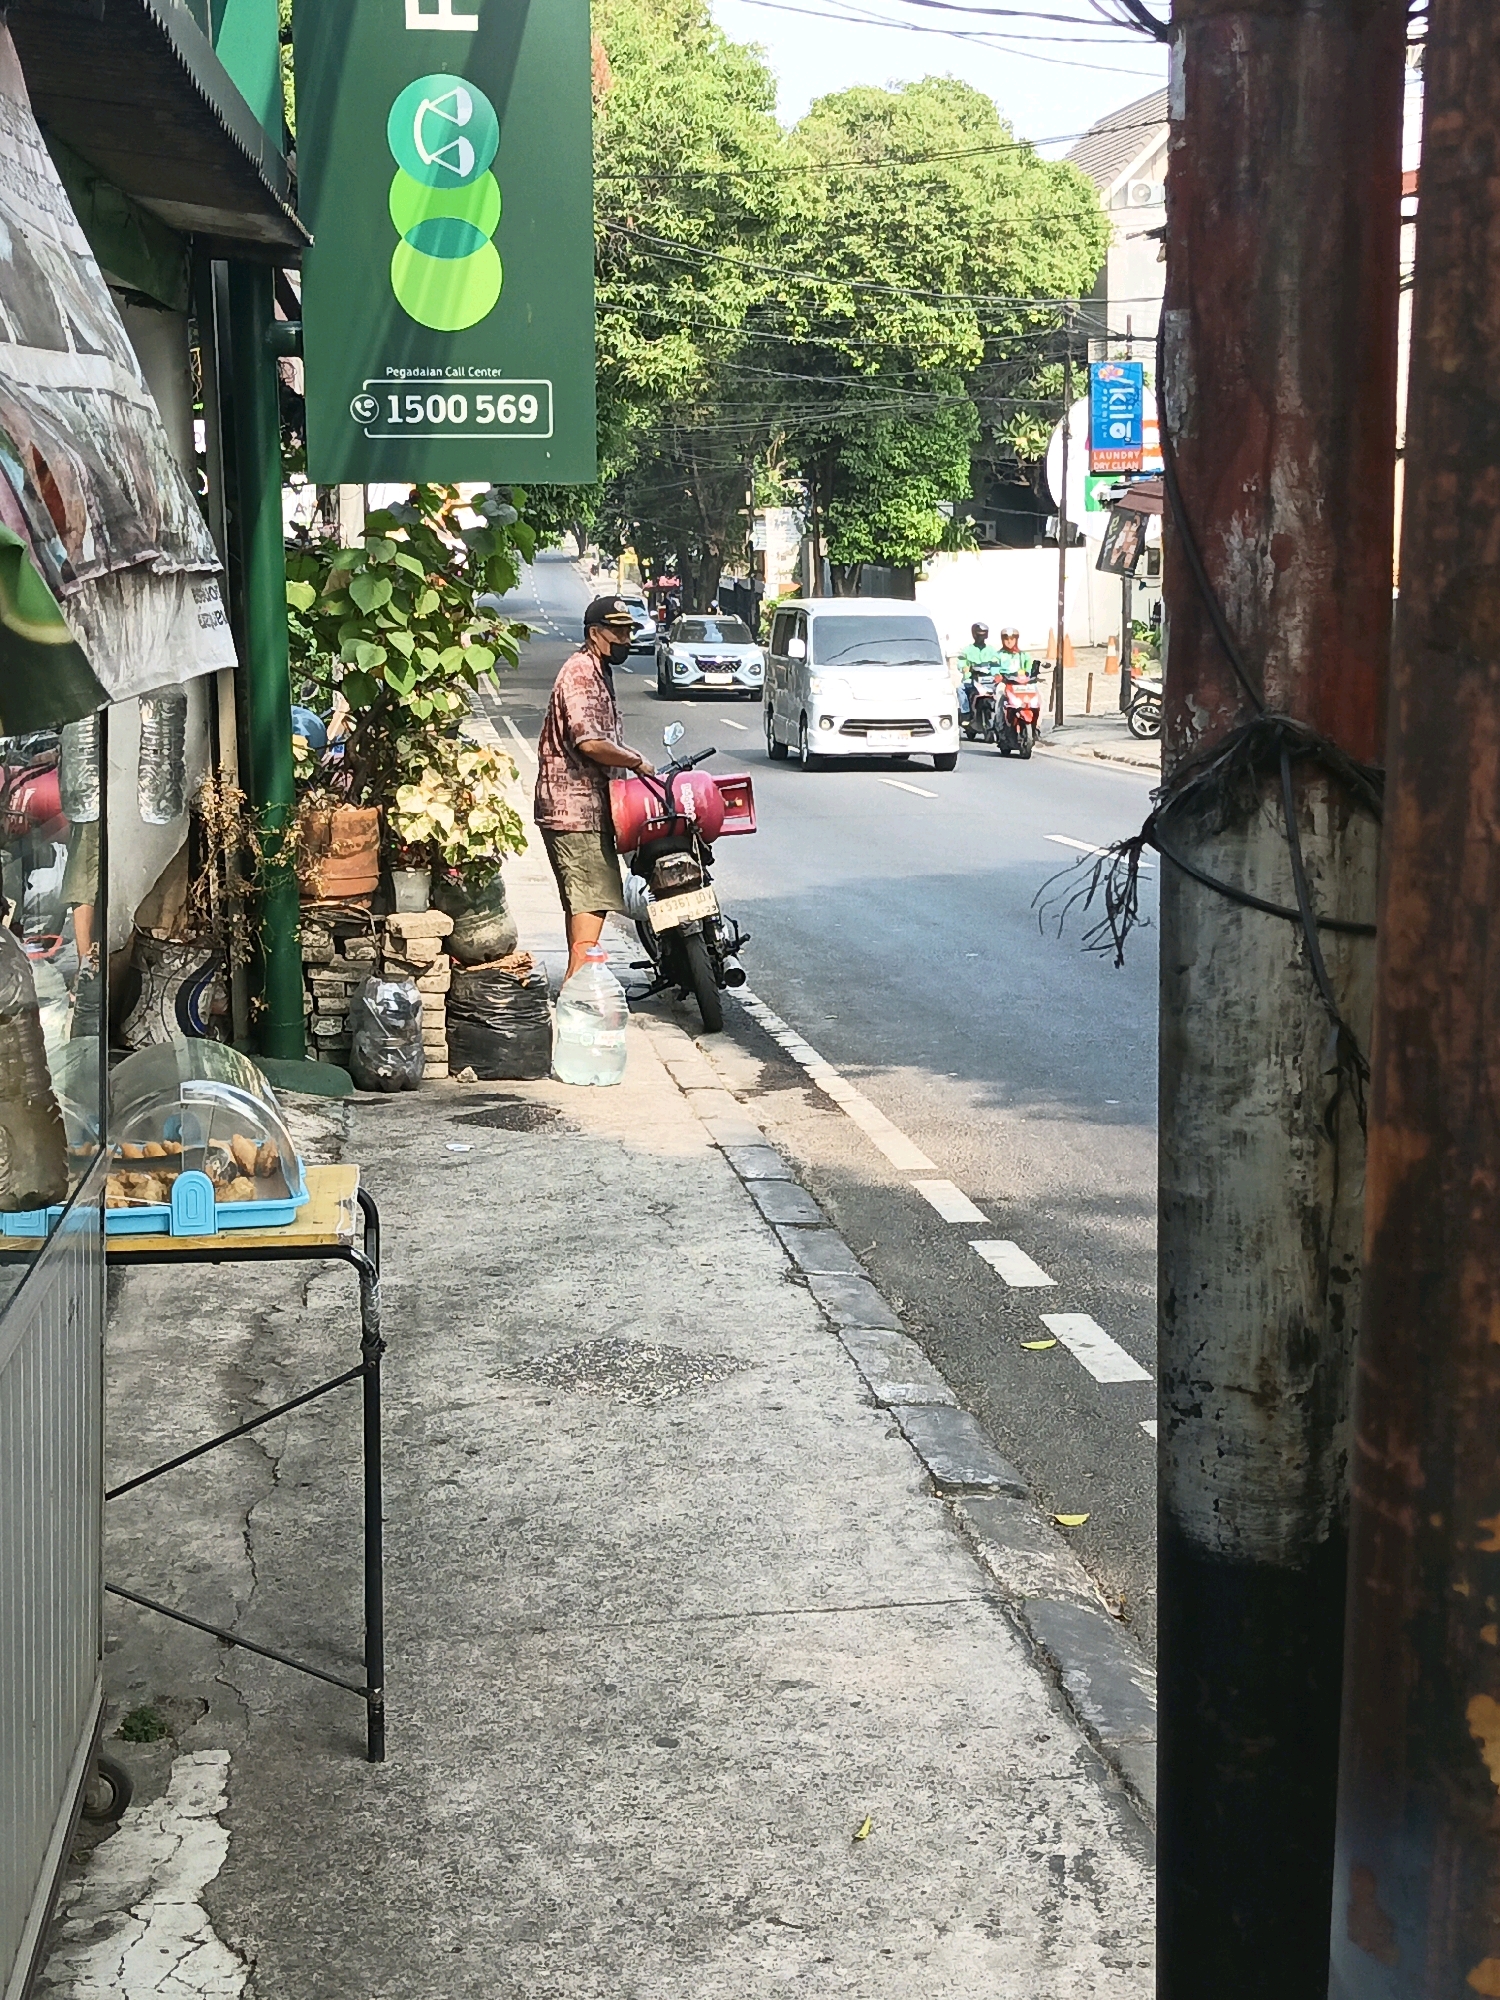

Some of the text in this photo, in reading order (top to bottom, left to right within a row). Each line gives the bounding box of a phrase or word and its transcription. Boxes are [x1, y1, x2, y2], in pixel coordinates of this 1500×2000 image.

[386, 366, 502, 379] Pegadaian Call Center
[387, 394, 539, 424] 1500 569
[1093, 451, 1140, 460] LAUNDRY
[1093, 461, 1139, 470] DRY CLEAN
